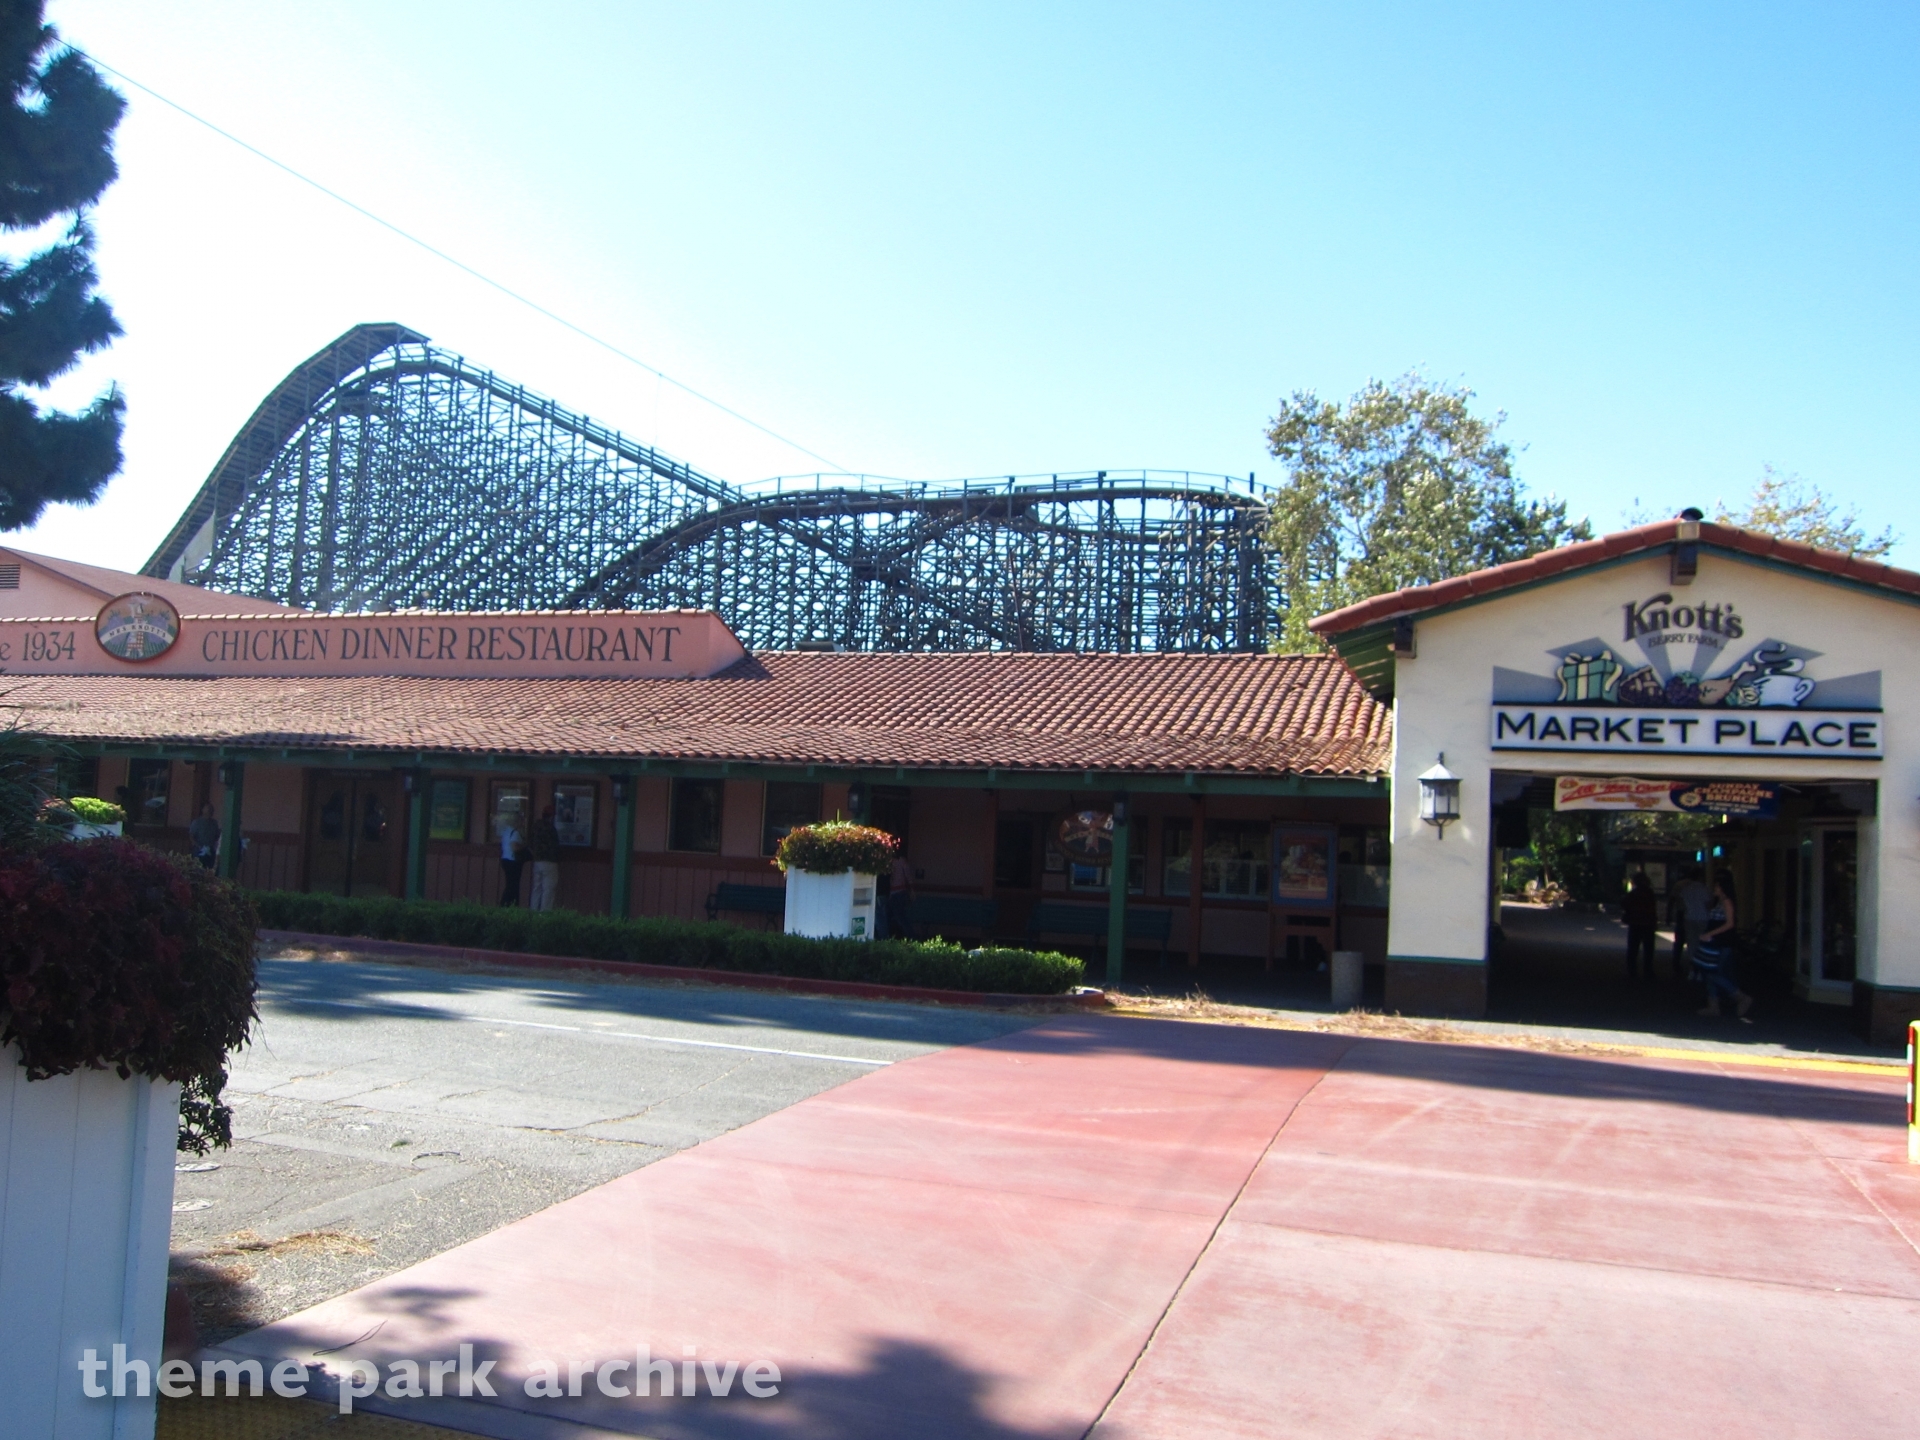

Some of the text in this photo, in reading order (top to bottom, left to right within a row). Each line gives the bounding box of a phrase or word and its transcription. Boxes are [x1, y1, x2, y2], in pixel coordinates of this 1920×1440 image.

[1622, 592, 1744, 642] Knott's
[23, 631, 76, 661] 1934
[202, 626, 681, 662] CHICKEN DINNER RESTAURANT
[1648, 633, 1718, 648] BERRY FARM
[1497, 711, 1877, 748] MARKET PLACE
[1694, 787, 1774, 799] CHAMPAGNE
[1709, 782, 1760, 790] SUNDAY
[1705, 793, 1760, 804] BRUNCH
